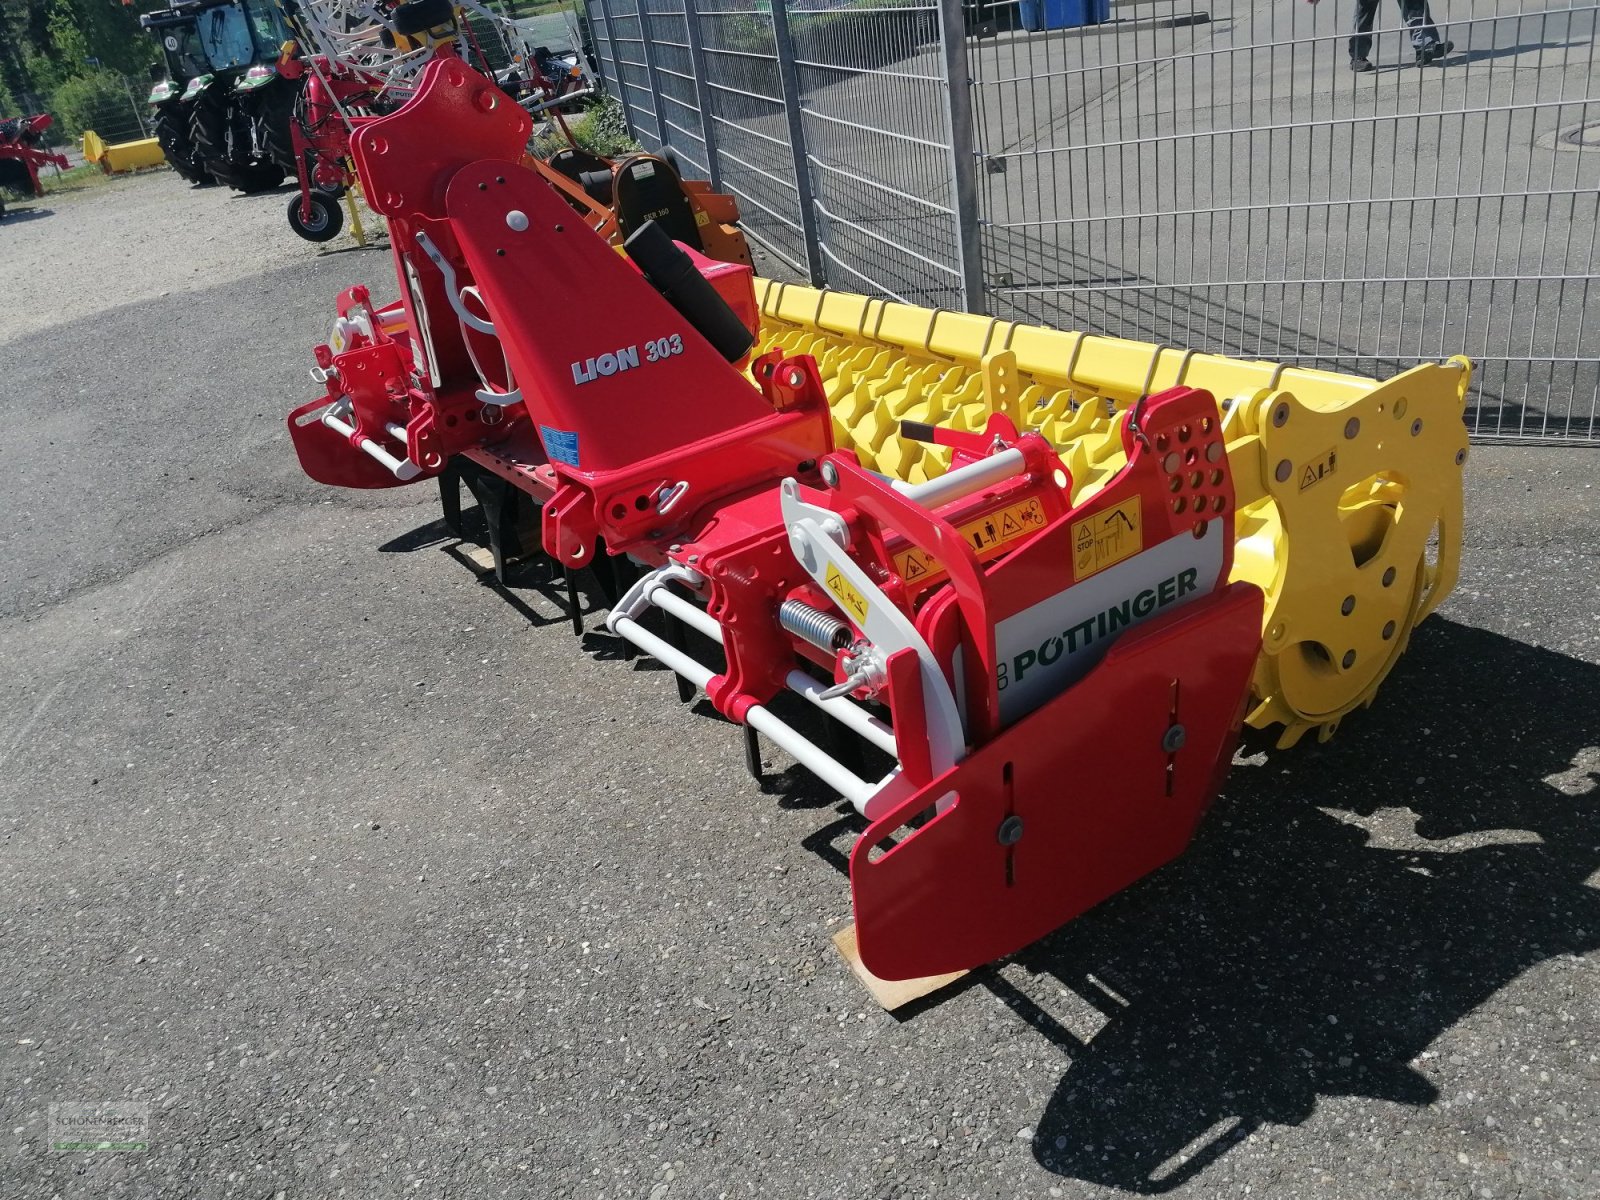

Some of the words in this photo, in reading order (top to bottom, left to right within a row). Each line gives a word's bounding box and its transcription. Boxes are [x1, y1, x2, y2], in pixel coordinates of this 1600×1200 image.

[166, 38, 176, 48] 40
[658, 207, 670, 217] 160
[571, 345, 640, 385] LION
[645, 333, 684, 362] 303
[1077, 538, 1094, 553] STOP
[1013, 567, 1198, 682] PÖTTINGER
